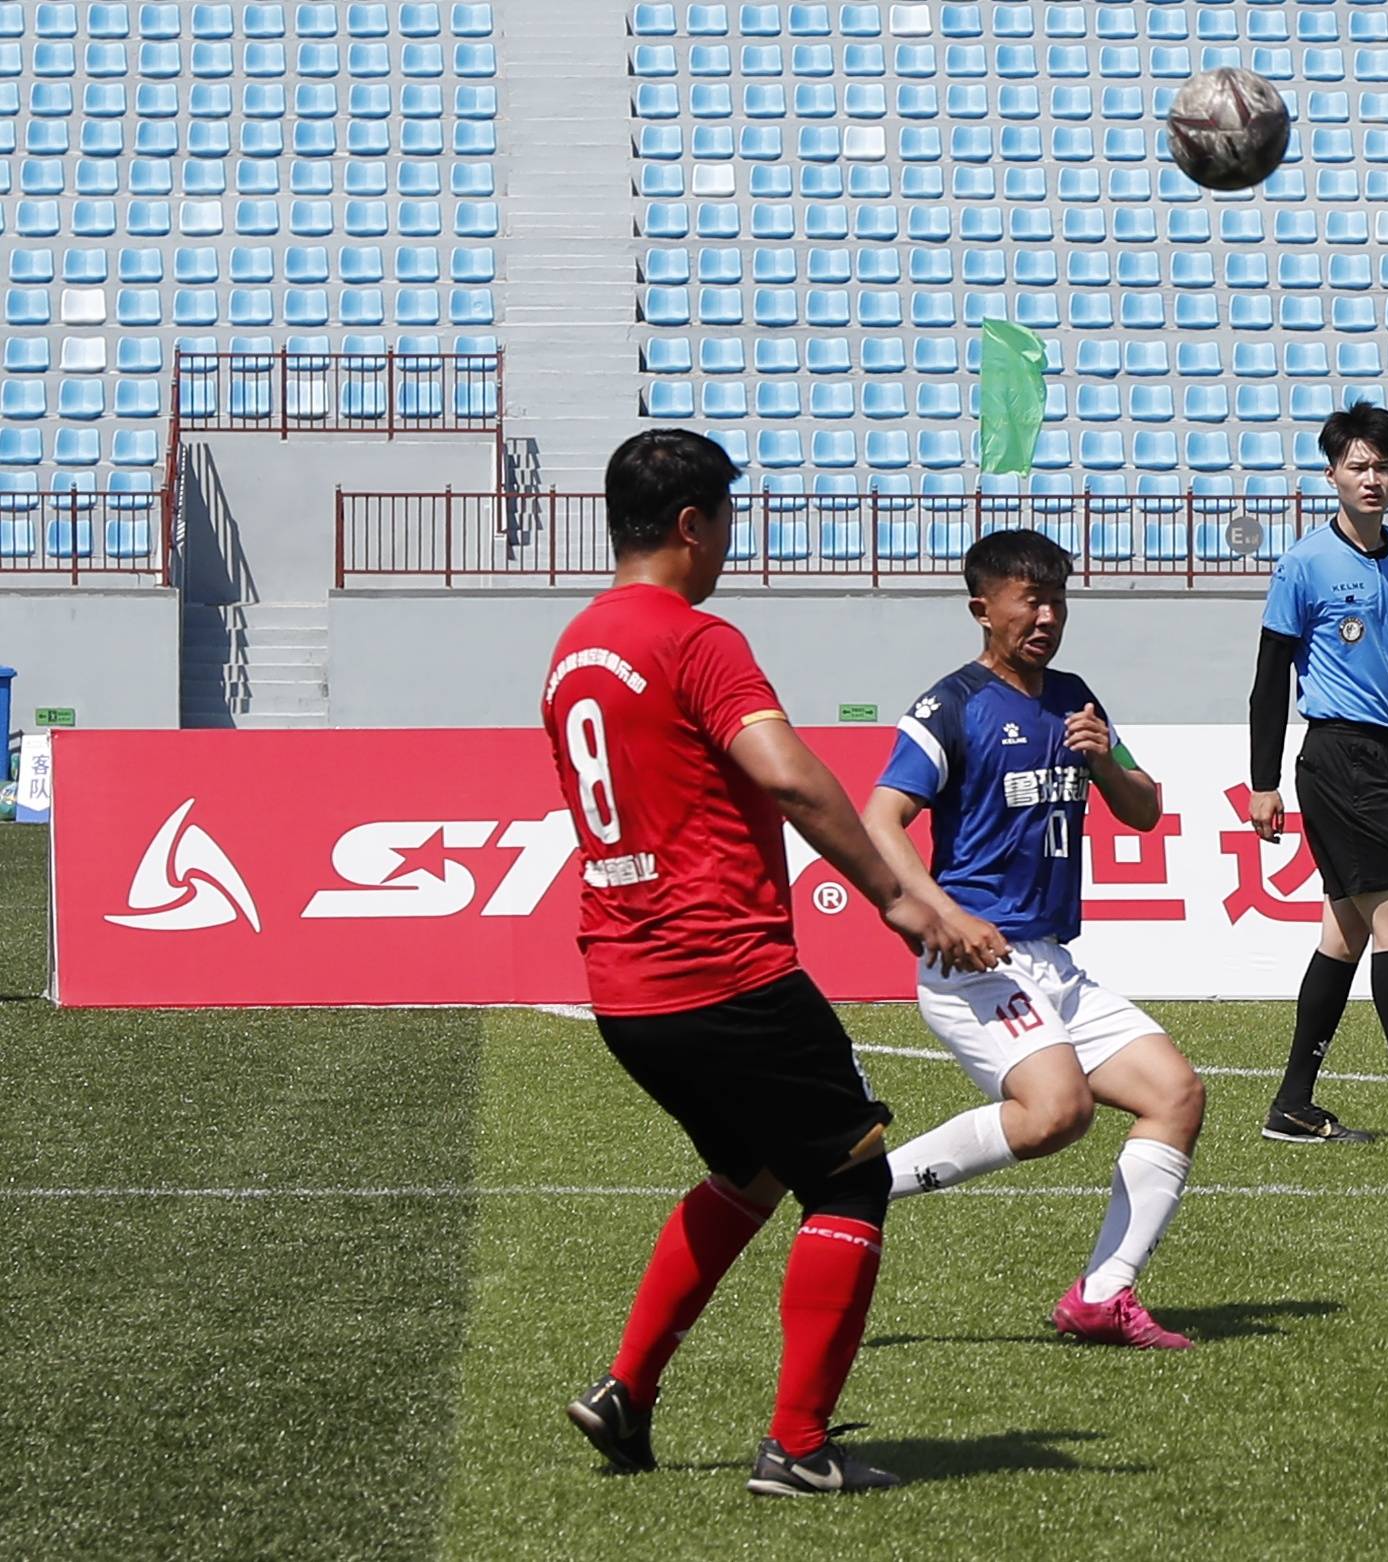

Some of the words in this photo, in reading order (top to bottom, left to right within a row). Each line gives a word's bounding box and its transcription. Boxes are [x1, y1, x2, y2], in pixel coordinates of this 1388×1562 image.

[1332, 582, 1365, 592] KELME
[566, 698, 620, 845] 8
[995, 992, 1044, 1038] 10
